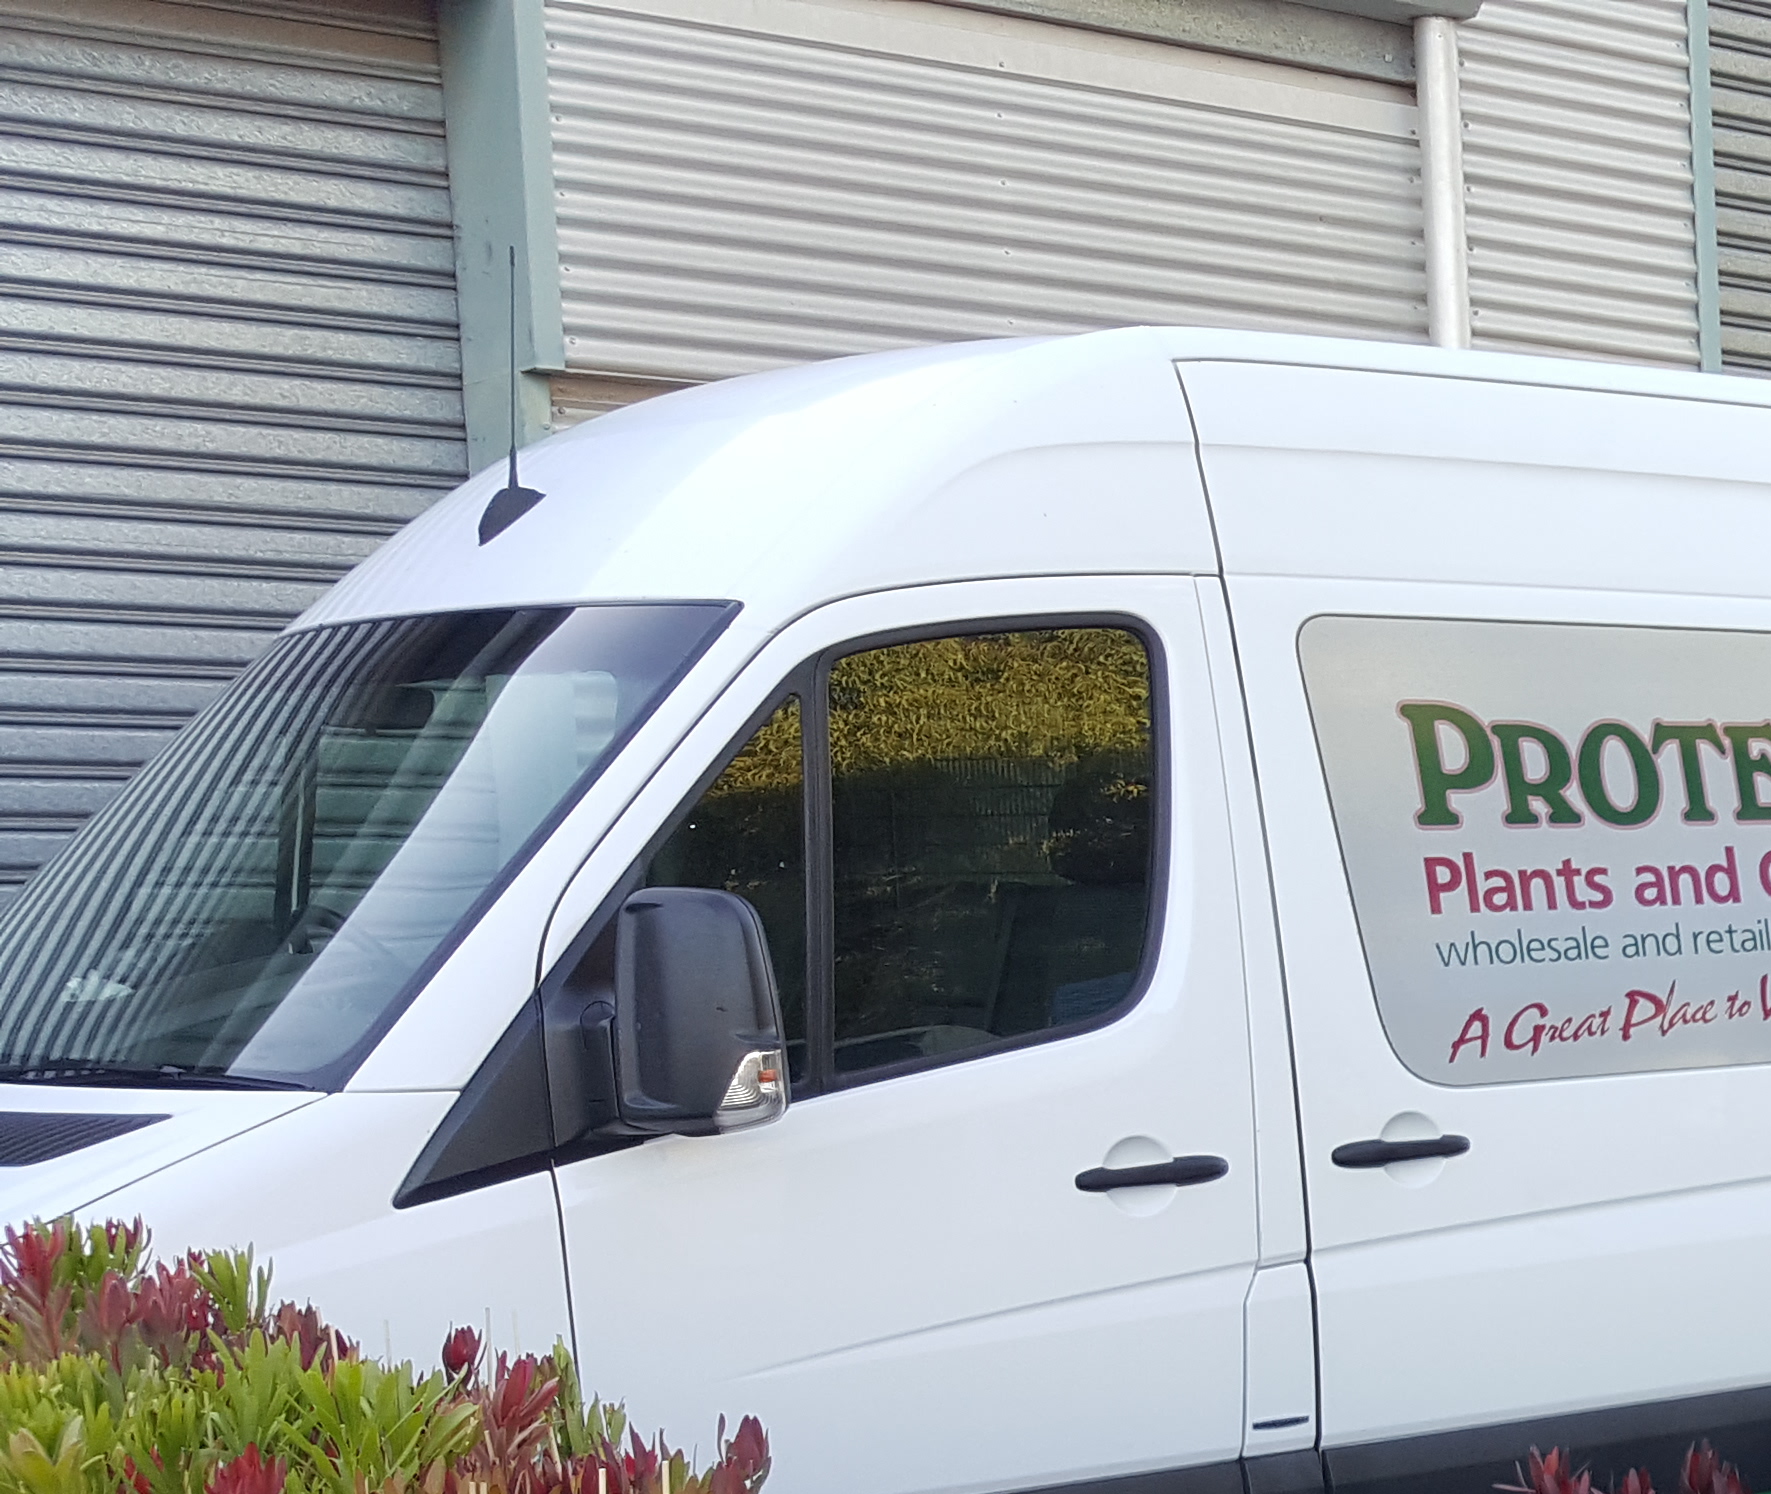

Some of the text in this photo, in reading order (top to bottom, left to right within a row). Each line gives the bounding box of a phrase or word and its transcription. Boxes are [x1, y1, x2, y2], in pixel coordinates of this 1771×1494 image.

[1423, 851, 1615, 915] Plants
[1634, 846, 1742, 907] and
[1435, 918, 1771, 967] wholesale and retail
[1448, 1007, 1492, 1064] A
[1503, 1001, 1613, 1057] Great
[1619, 979, 1718, 1042] Place
[1724, 990, 1752, 1022] to
